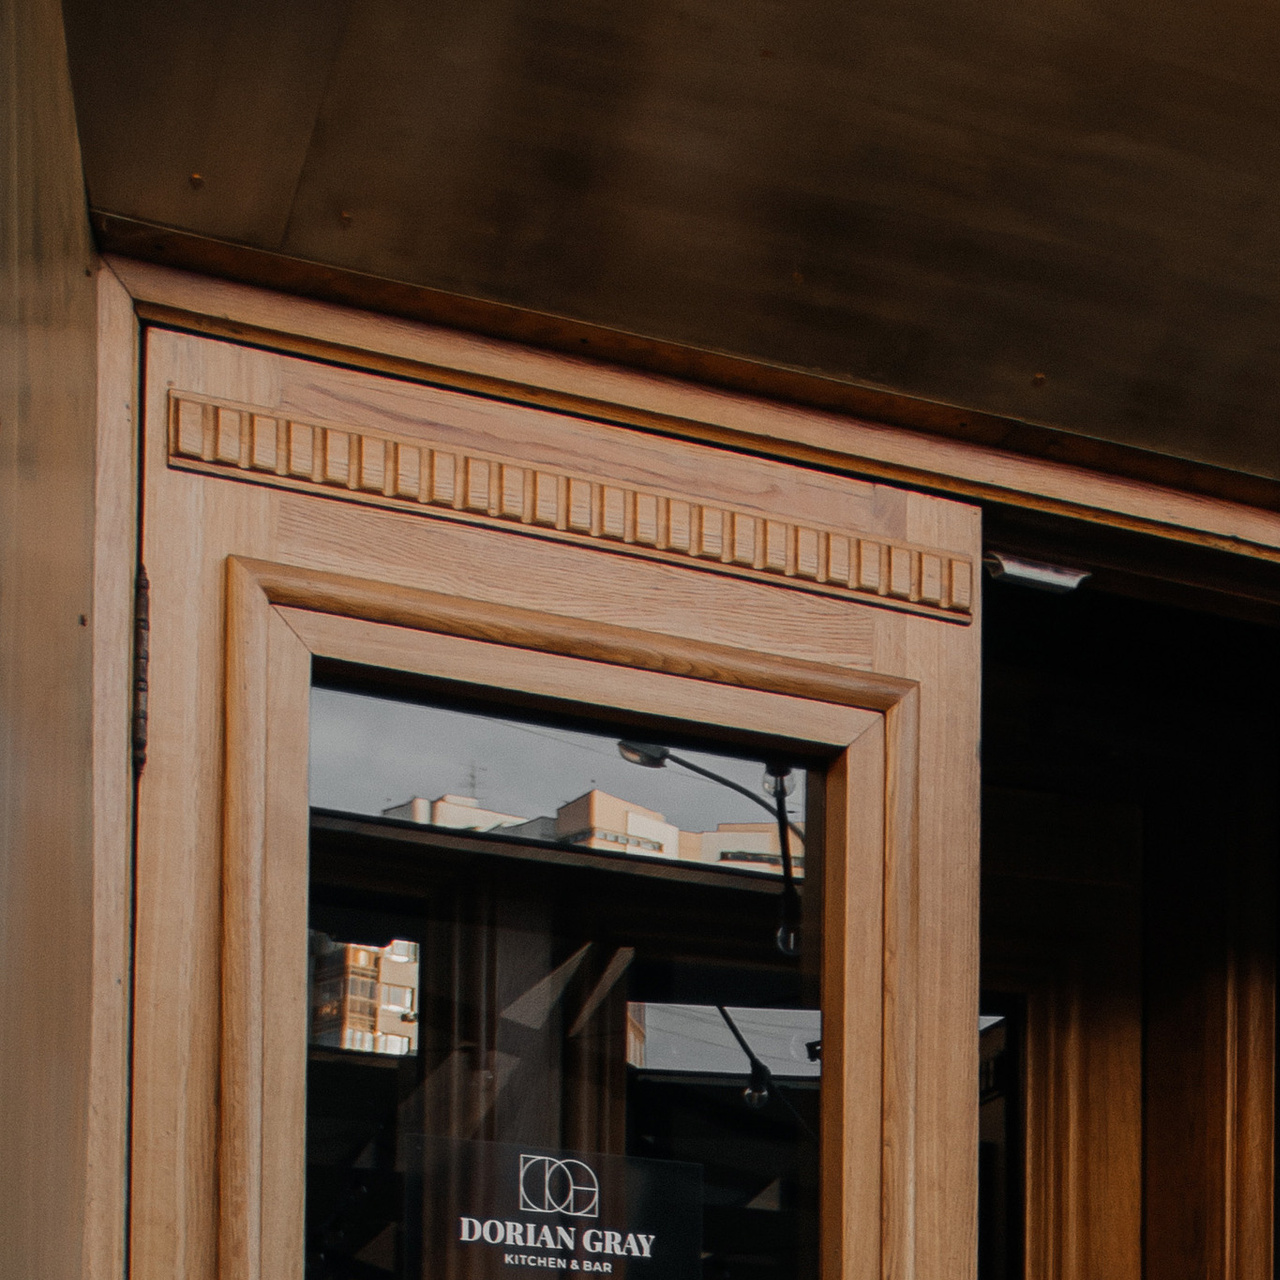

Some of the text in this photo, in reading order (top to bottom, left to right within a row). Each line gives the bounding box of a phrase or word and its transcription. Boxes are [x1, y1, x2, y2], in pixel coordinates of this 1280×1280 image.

[460, 1217, 656, 1258] DORIAN GRAY
[503, 1253, 613, 1274] KITCHEN & BAR
